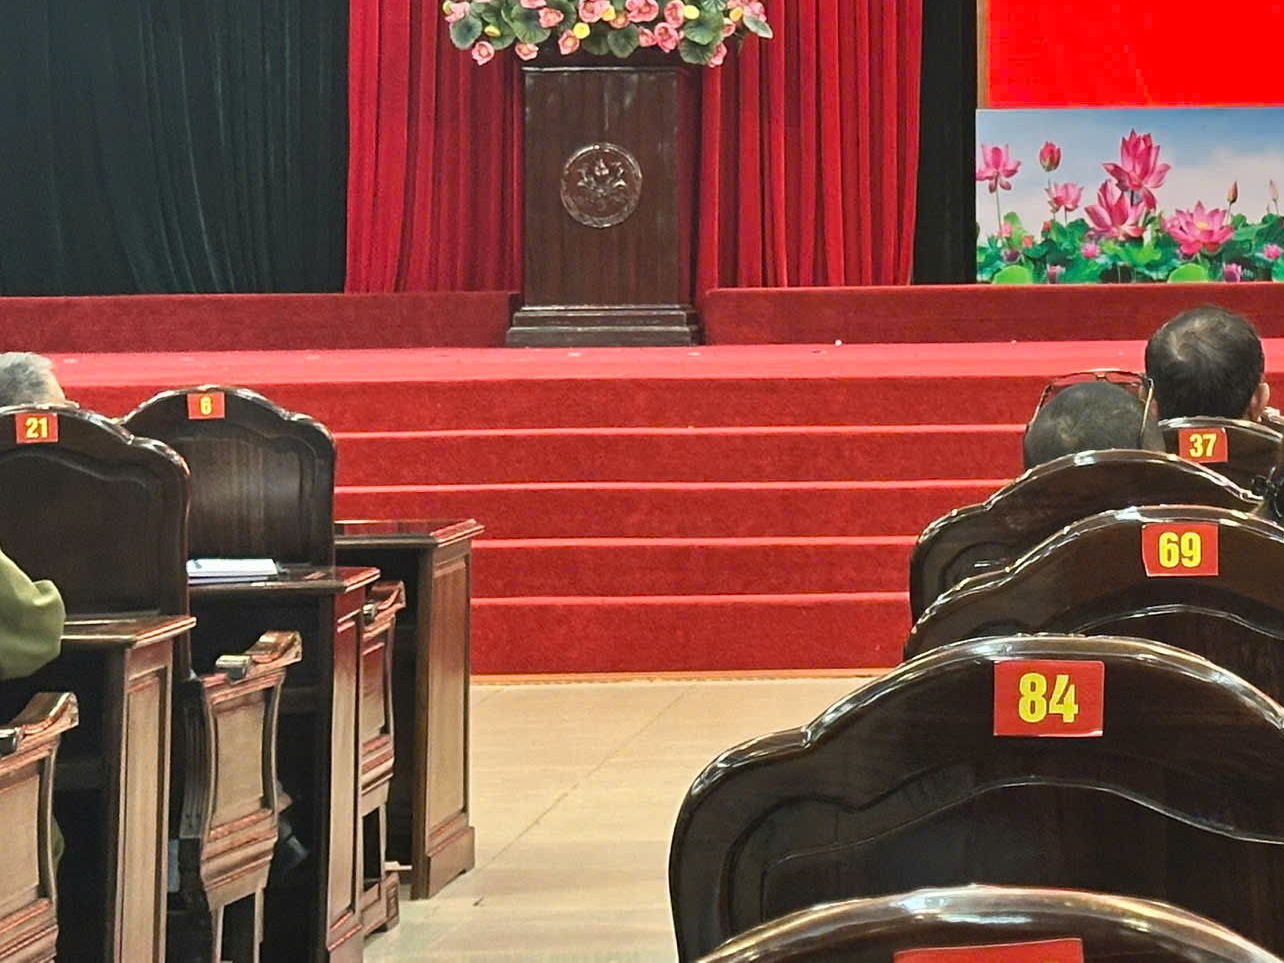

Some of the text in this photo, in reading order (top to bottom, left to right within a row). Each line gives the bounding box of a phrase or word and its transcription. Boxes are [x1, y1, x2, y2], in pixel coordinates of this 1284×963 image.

[198, 395, 214, 416] 6
[25, 416, 49, 439] 21
[1188, 433, 1217, 459] 37
[1157, 531, 1203, 570] 69
[1014, 673, 1080, 727] 84
